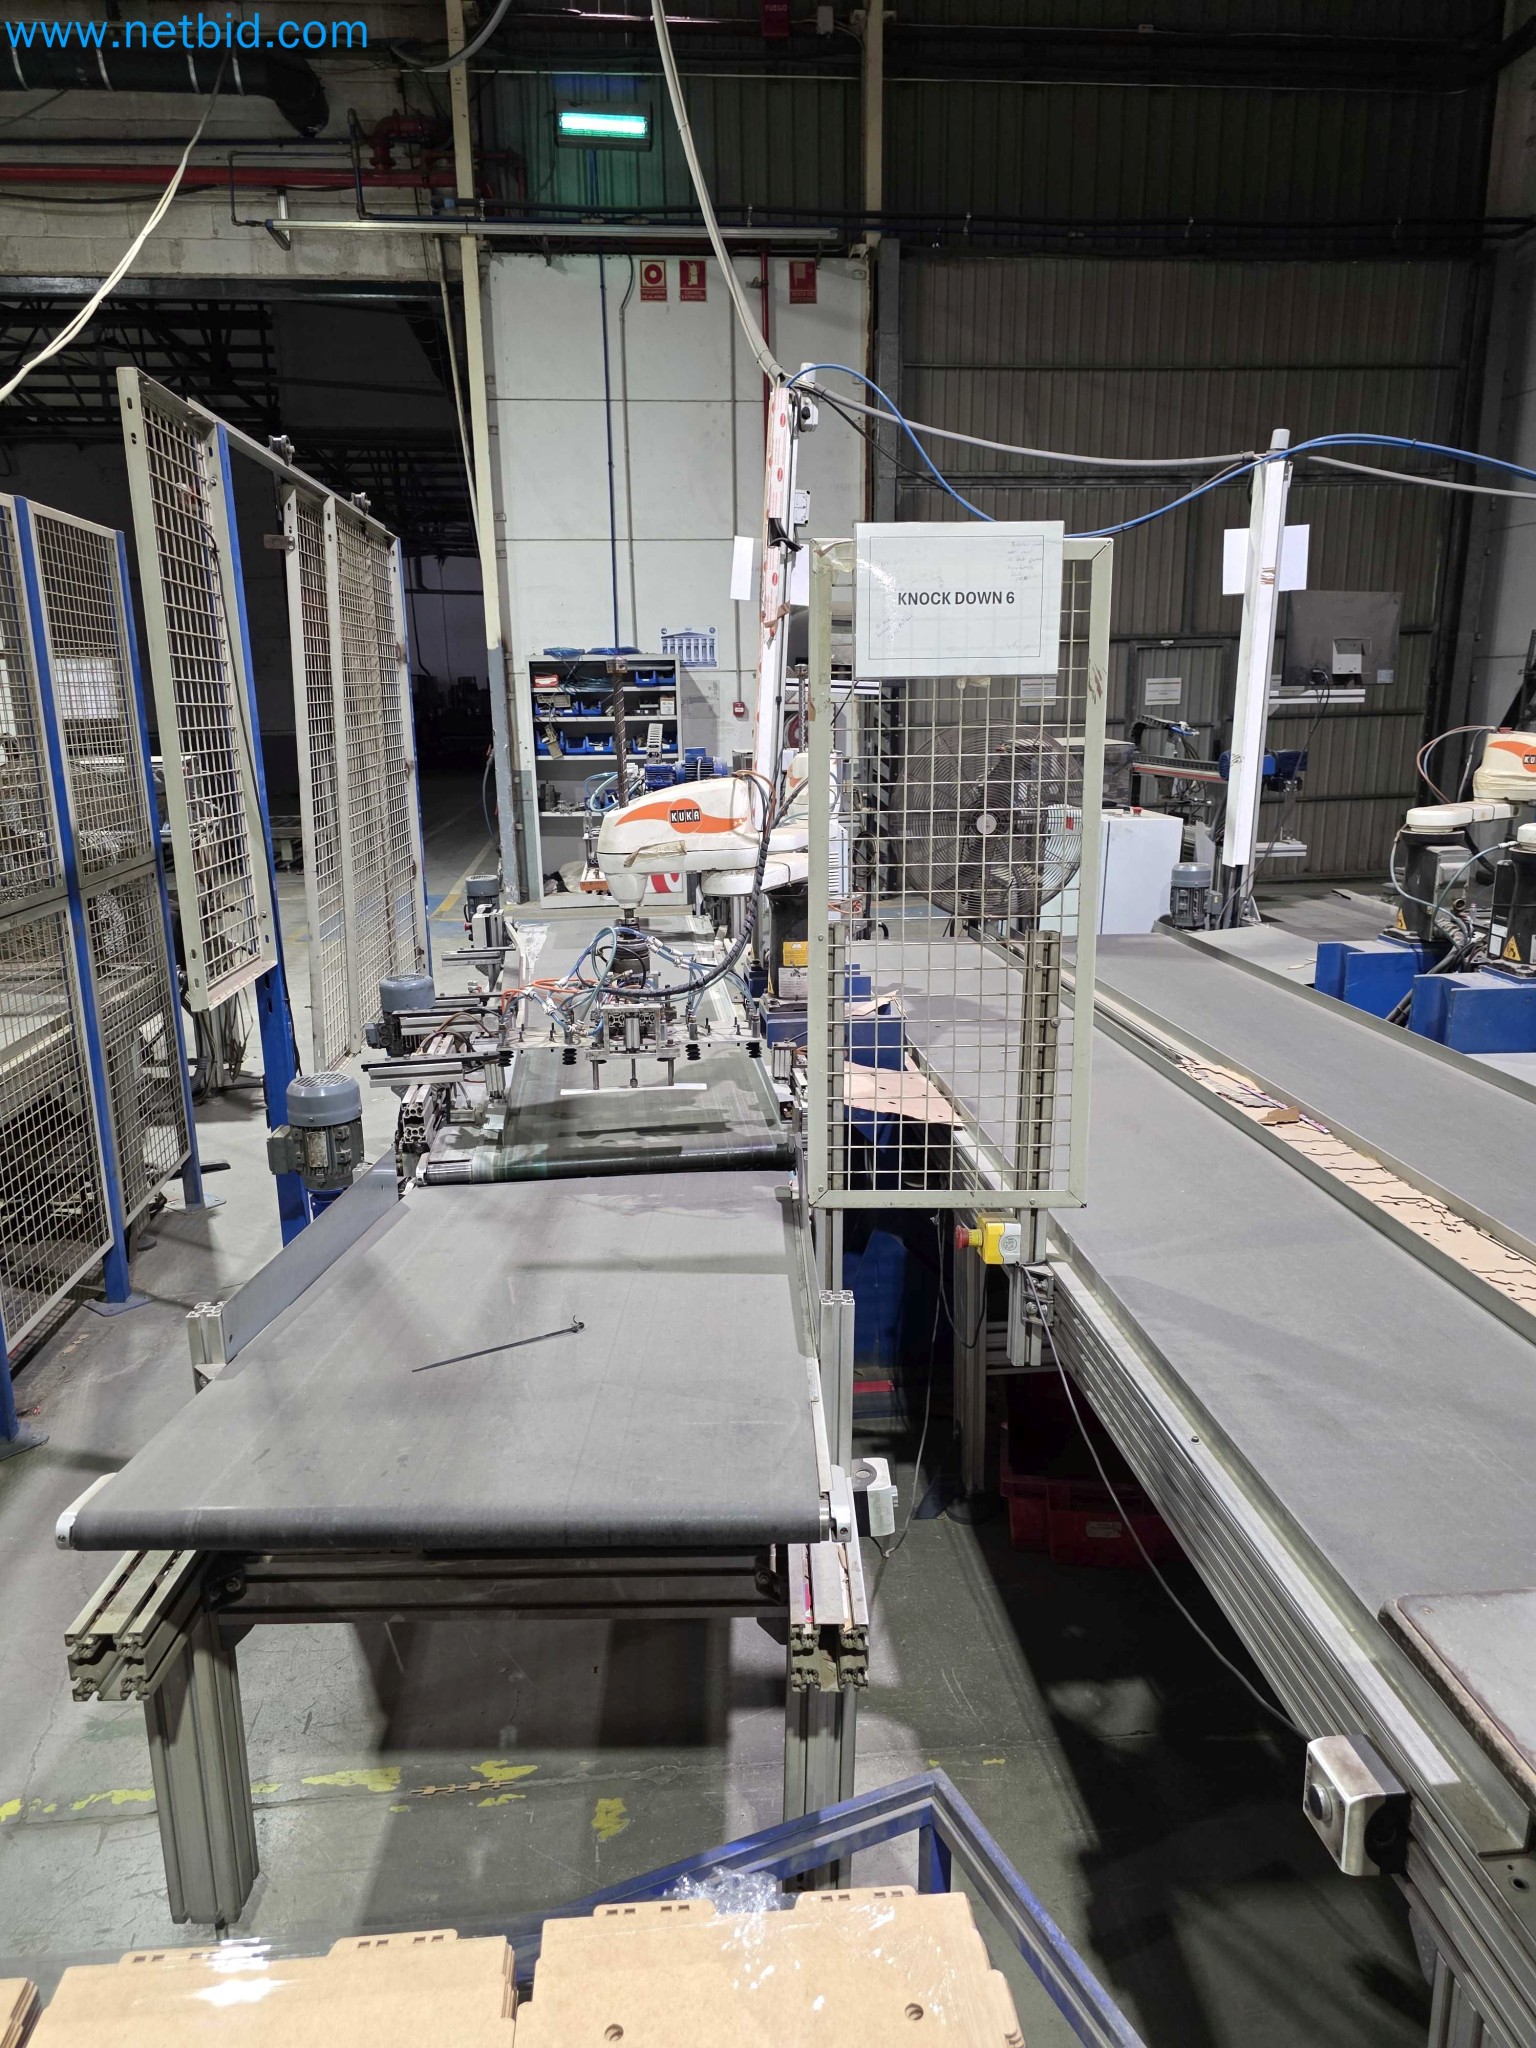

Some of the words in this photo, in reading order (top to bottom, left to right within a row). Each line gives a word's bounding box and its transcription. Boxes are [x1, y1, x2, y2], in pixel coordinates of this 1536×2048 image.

[897, 591, 951, 606] KNOCK
[955, 591, 1003, 605] DOWN
[1006, 591, 1015, 604] 6
[671, 809, 700, 822] KUKA
